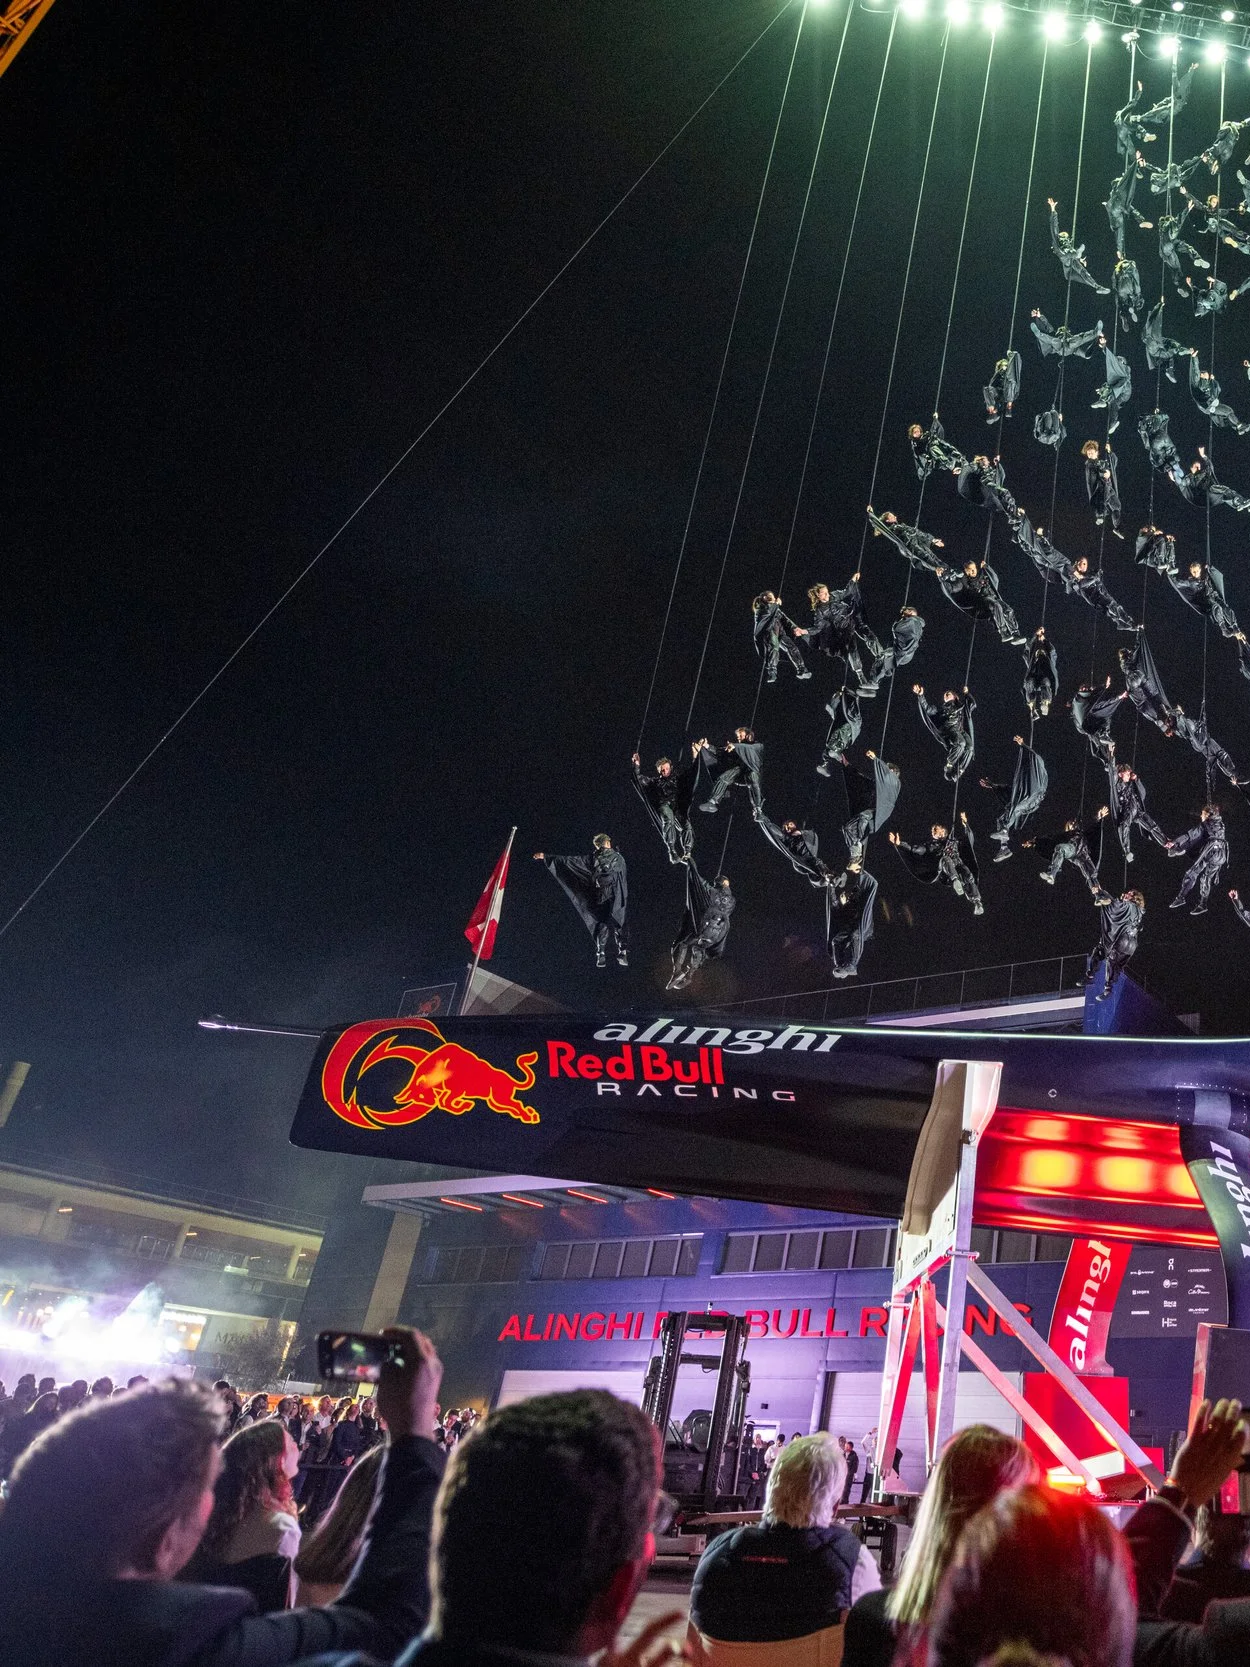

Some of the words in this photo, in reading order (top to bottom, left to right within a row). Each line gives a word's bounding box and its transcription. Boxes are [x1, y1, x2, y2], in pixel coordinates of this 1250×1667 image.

[593, 1018, 842, 1054] alinghi
[546, 1040, 635, 1081] Red
[640, 1045, 725, 1085] Bull
[597, 1082, 796, 1102] RACING
[1065, 1239, 1112, 1371] aling
[497, 1312, 645, 1342] ALINGHI
[744, 1307, 849, 1338] BULL
